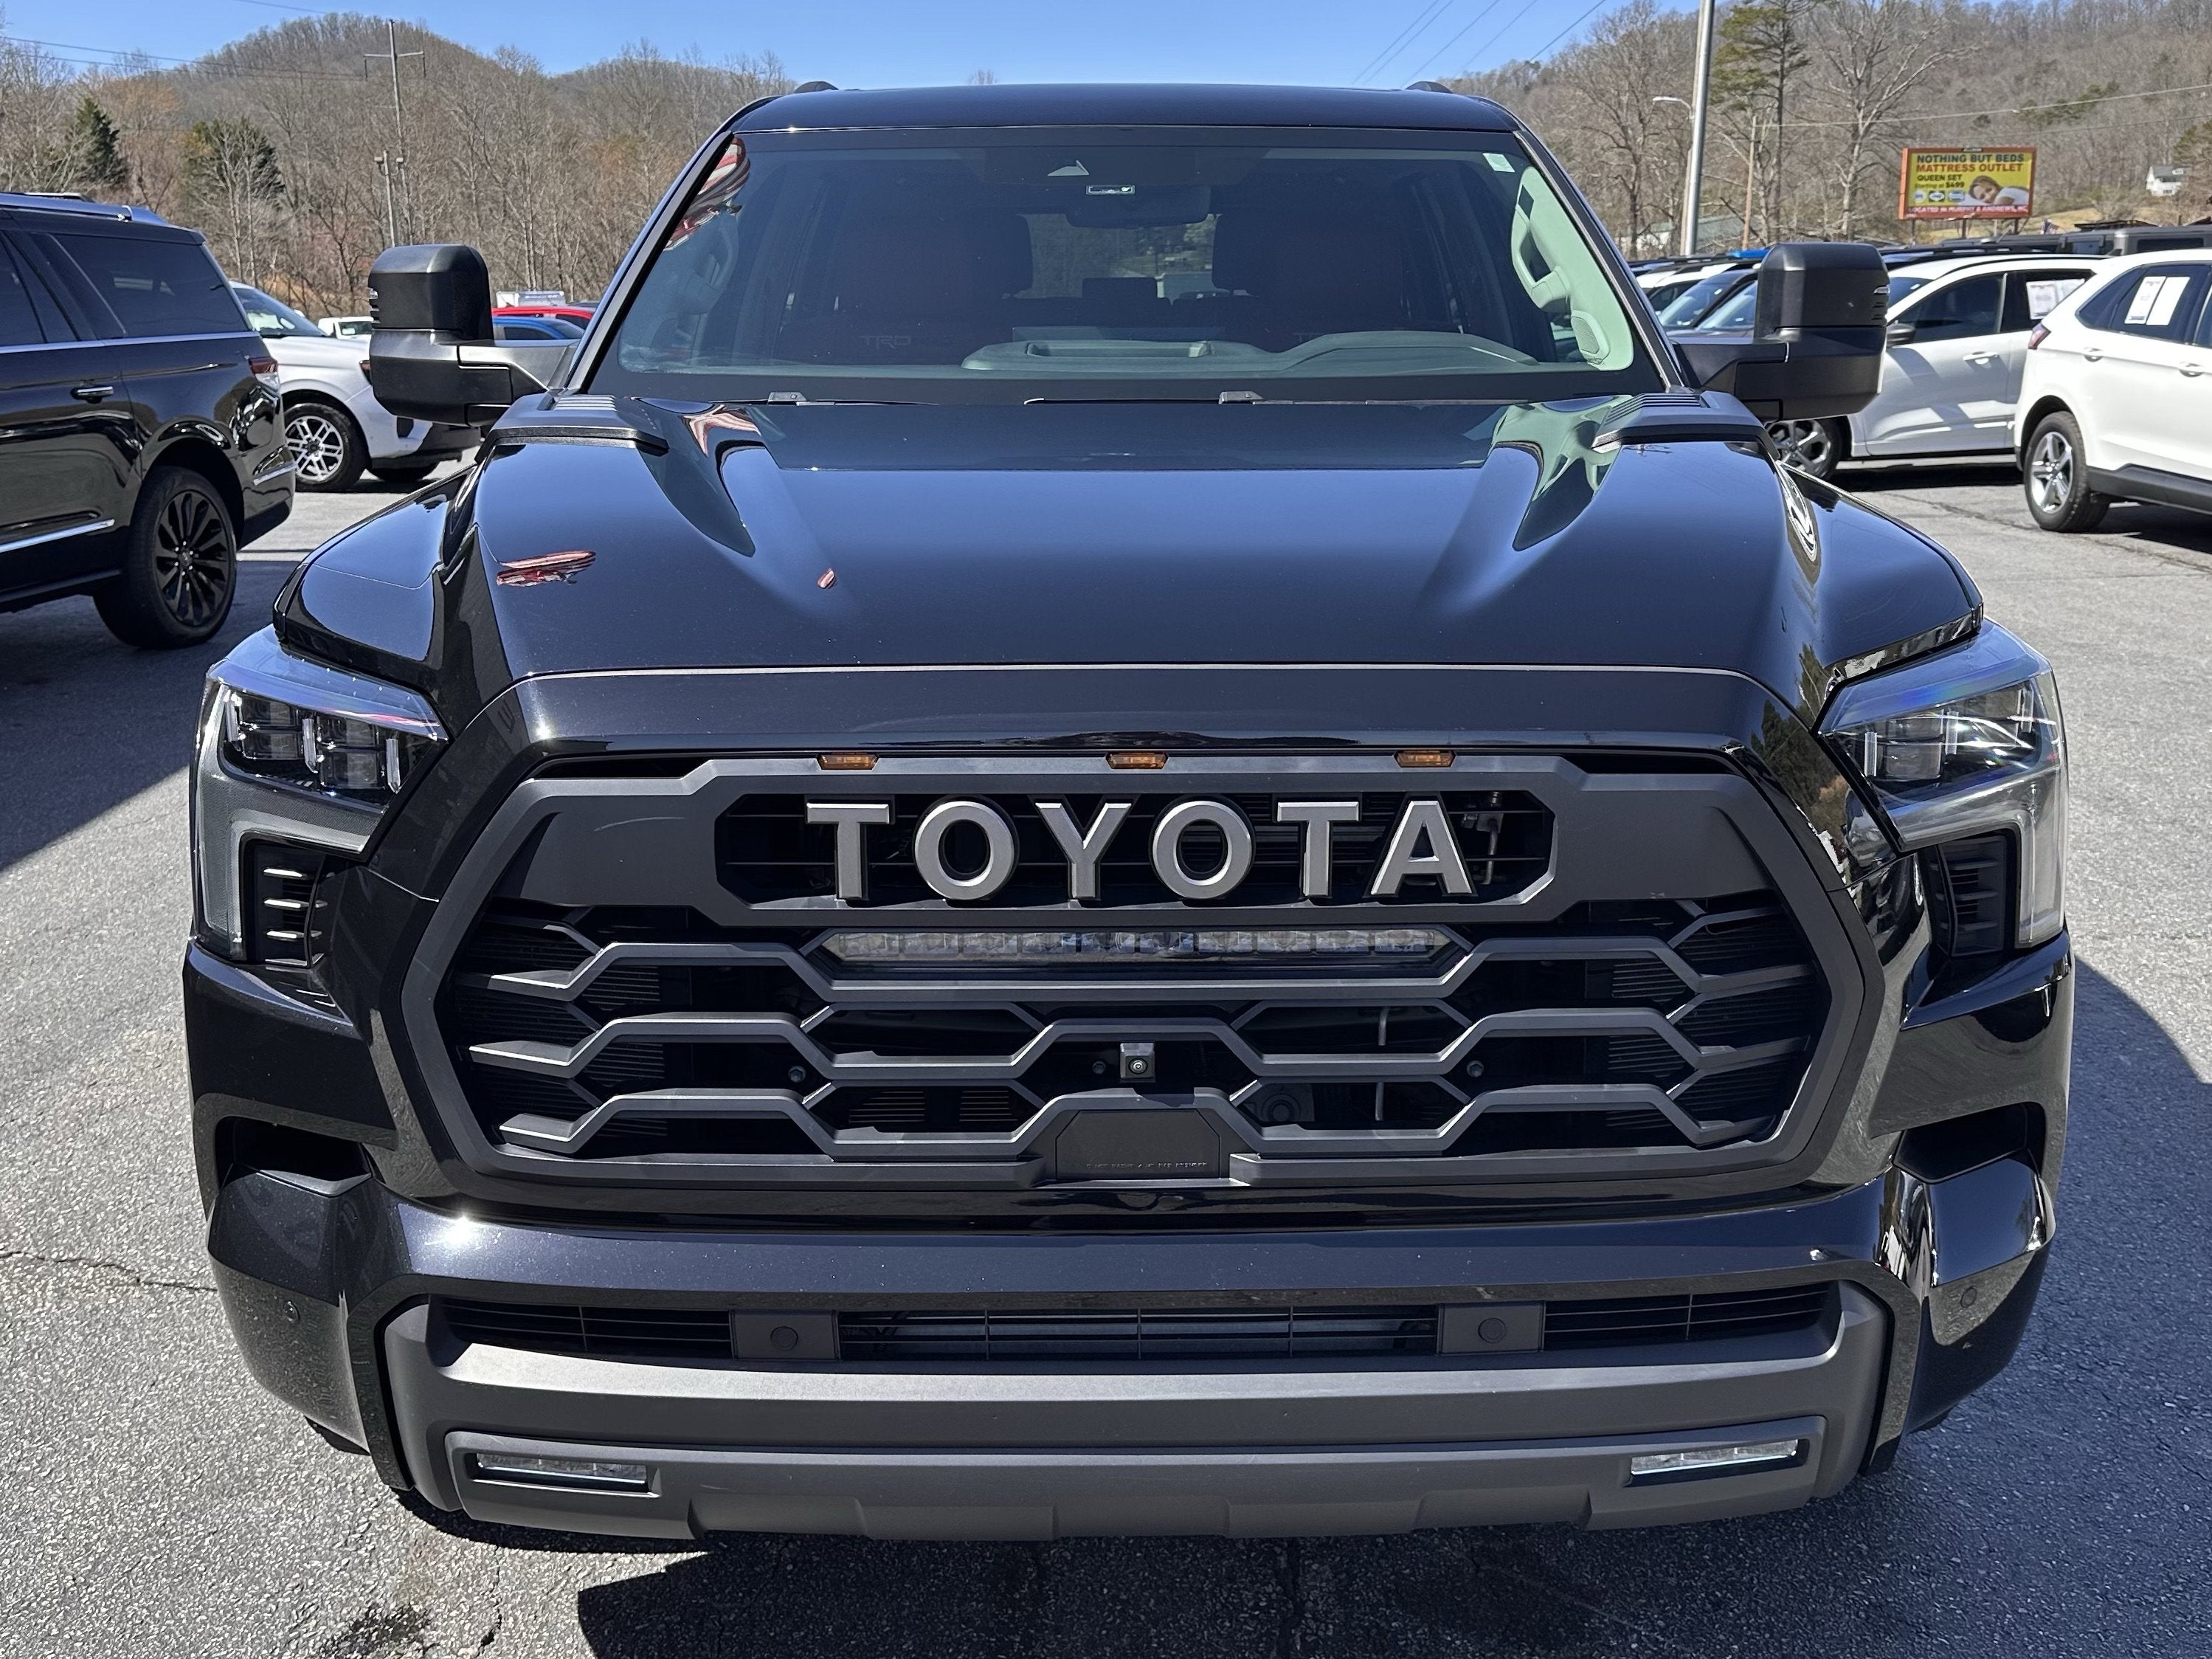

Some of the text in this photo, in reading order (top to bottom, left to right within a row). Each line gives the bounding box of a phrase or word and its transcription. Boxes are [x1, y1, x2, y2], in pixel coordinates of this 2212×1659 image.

[1917, 154, 2025, 163] NOTHING BUT BEDS
[1916, 163, 2023, 172] MATTRESS OUTLET
[859, 335, 911, 350] TRD
[806, 800, 1473, 900] TOYOTA
